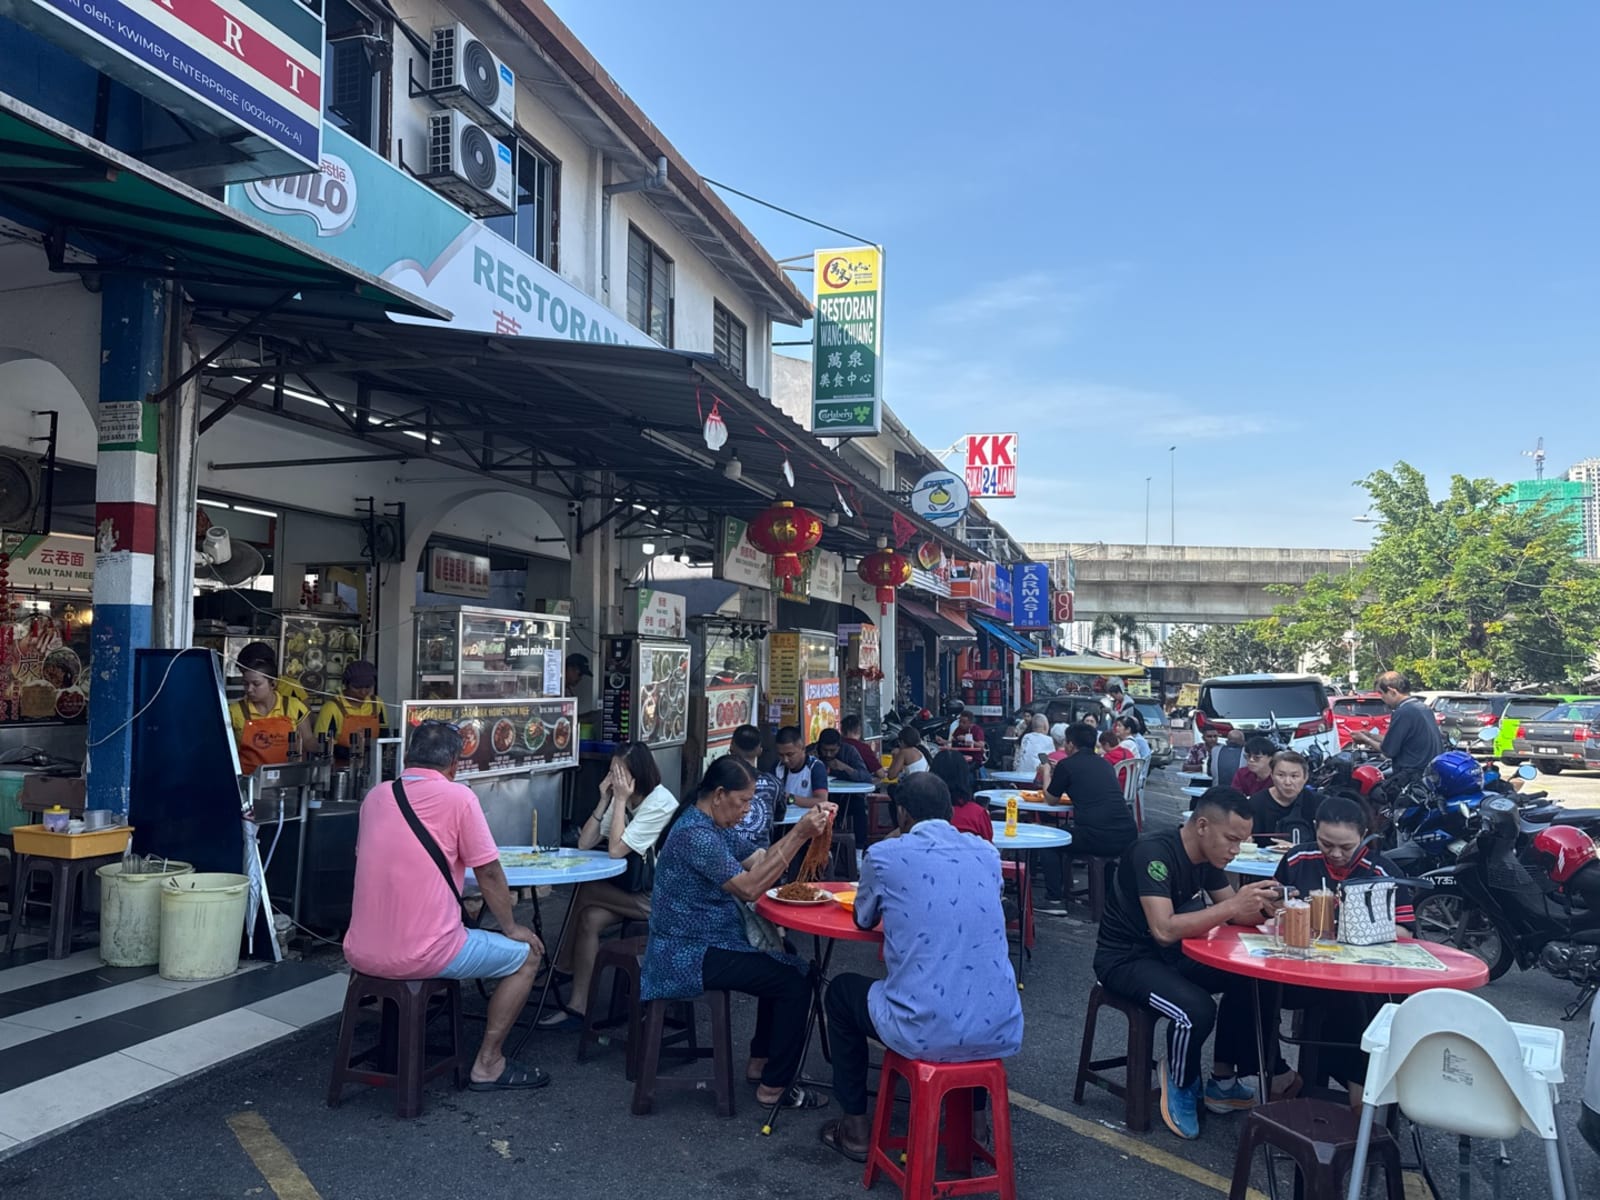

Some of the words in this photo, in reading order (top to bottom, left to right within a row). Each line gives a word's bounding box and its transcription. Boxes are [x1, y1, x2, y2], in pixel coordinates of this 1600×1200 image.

[83, 3, 116, 29] oleh:
[118, 22, 170, 61] KWIMBY
[172, 56, 239, 106] ENTERPRISE
[473, 245, 619, 345] RESTORAN
[821, 295, 874, 322] RESTORAN
[821, 323, 842, 347] WANG
[844, 321, 873, 345] CHUANG
[818, 408, 853, 423] Carlsberg
[969, 435, 1013, 465] KK
[983, 467, 997, 494] 24
[41, 549, 85, 567] 云吞面
[28, 567, 51, 577] WAN
[53, 569, 72, 578] TAN
[74, 571, 94, 580] MEE
[1022, 565, 1039, 618] FARMASI
